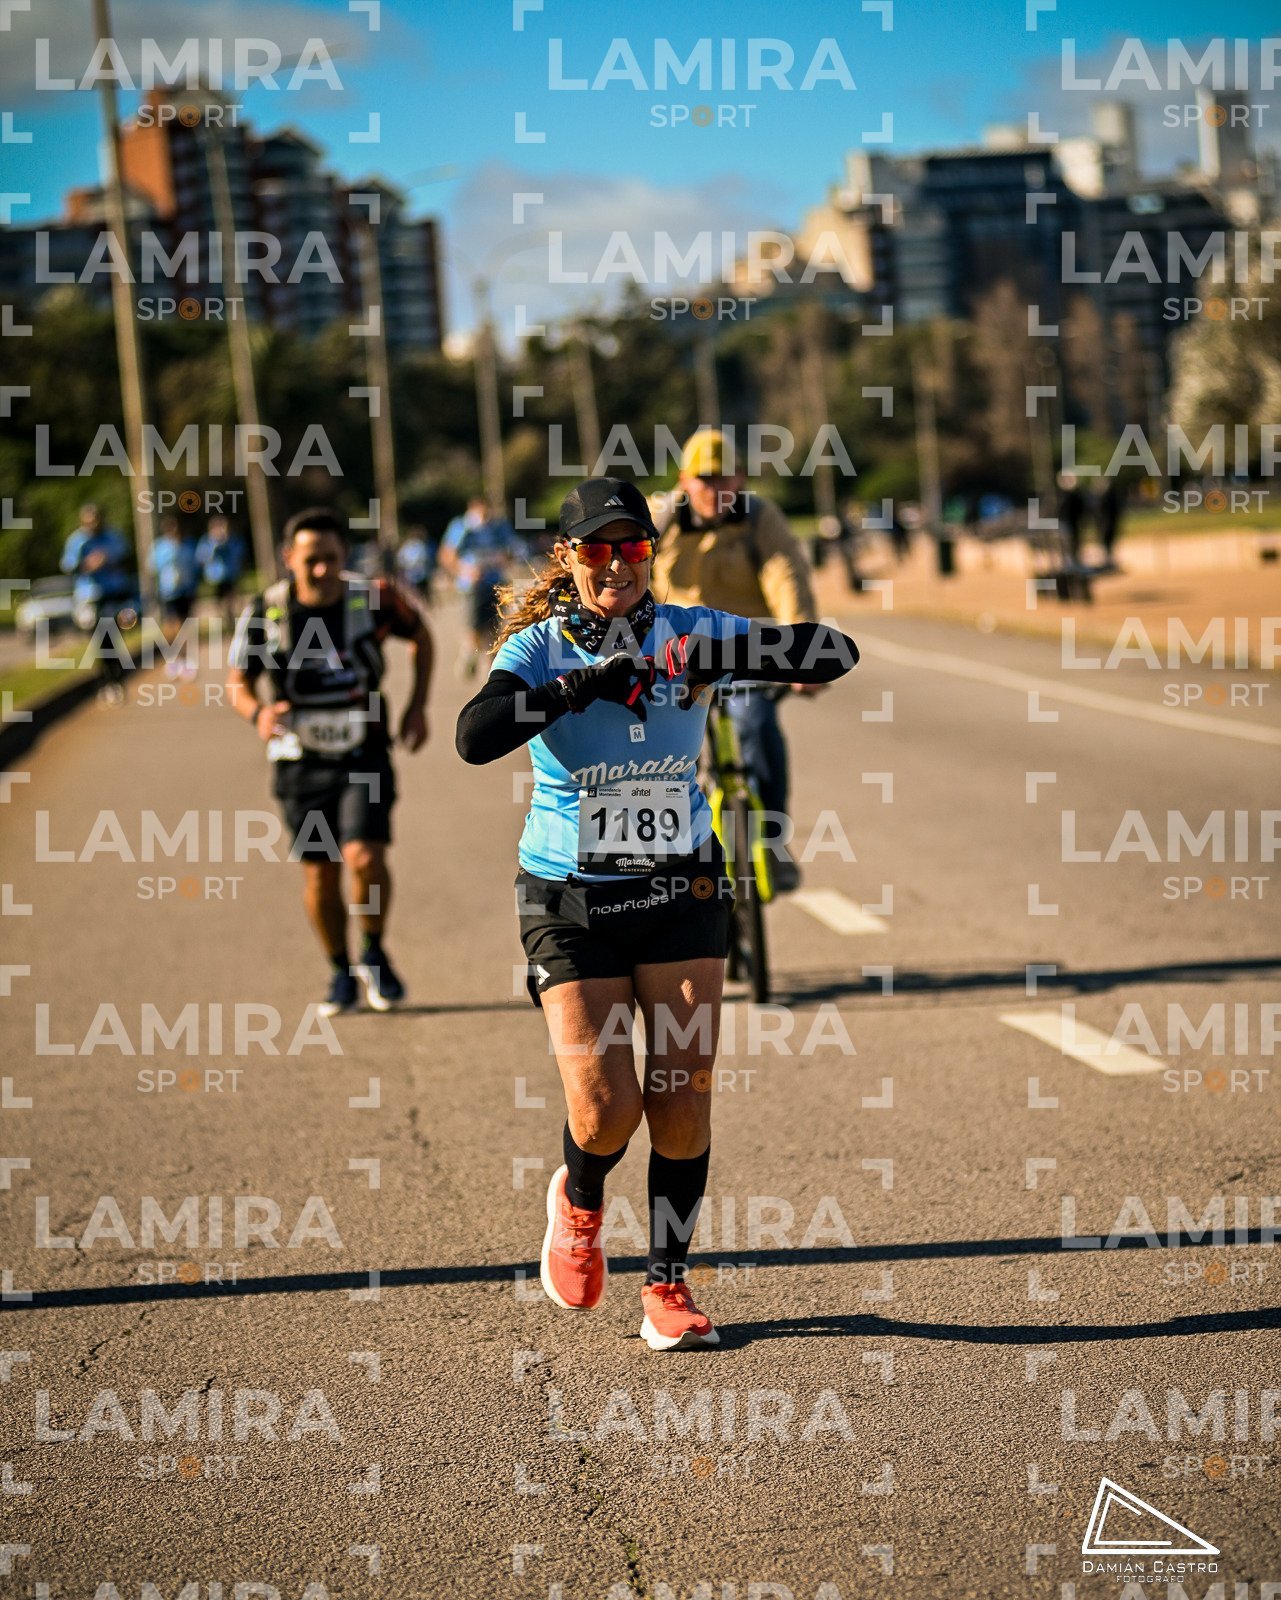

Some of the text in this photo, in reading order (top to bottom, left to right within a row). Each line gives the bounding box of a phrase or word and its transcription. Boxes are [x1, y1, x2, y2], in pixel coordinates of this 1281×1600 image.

[631, 788, 651, 797] antel
[590, 807, 680, 842] 1189
[615, 857, 656, 868] Maratón
[589, 894, 670, 915] noaflojes
